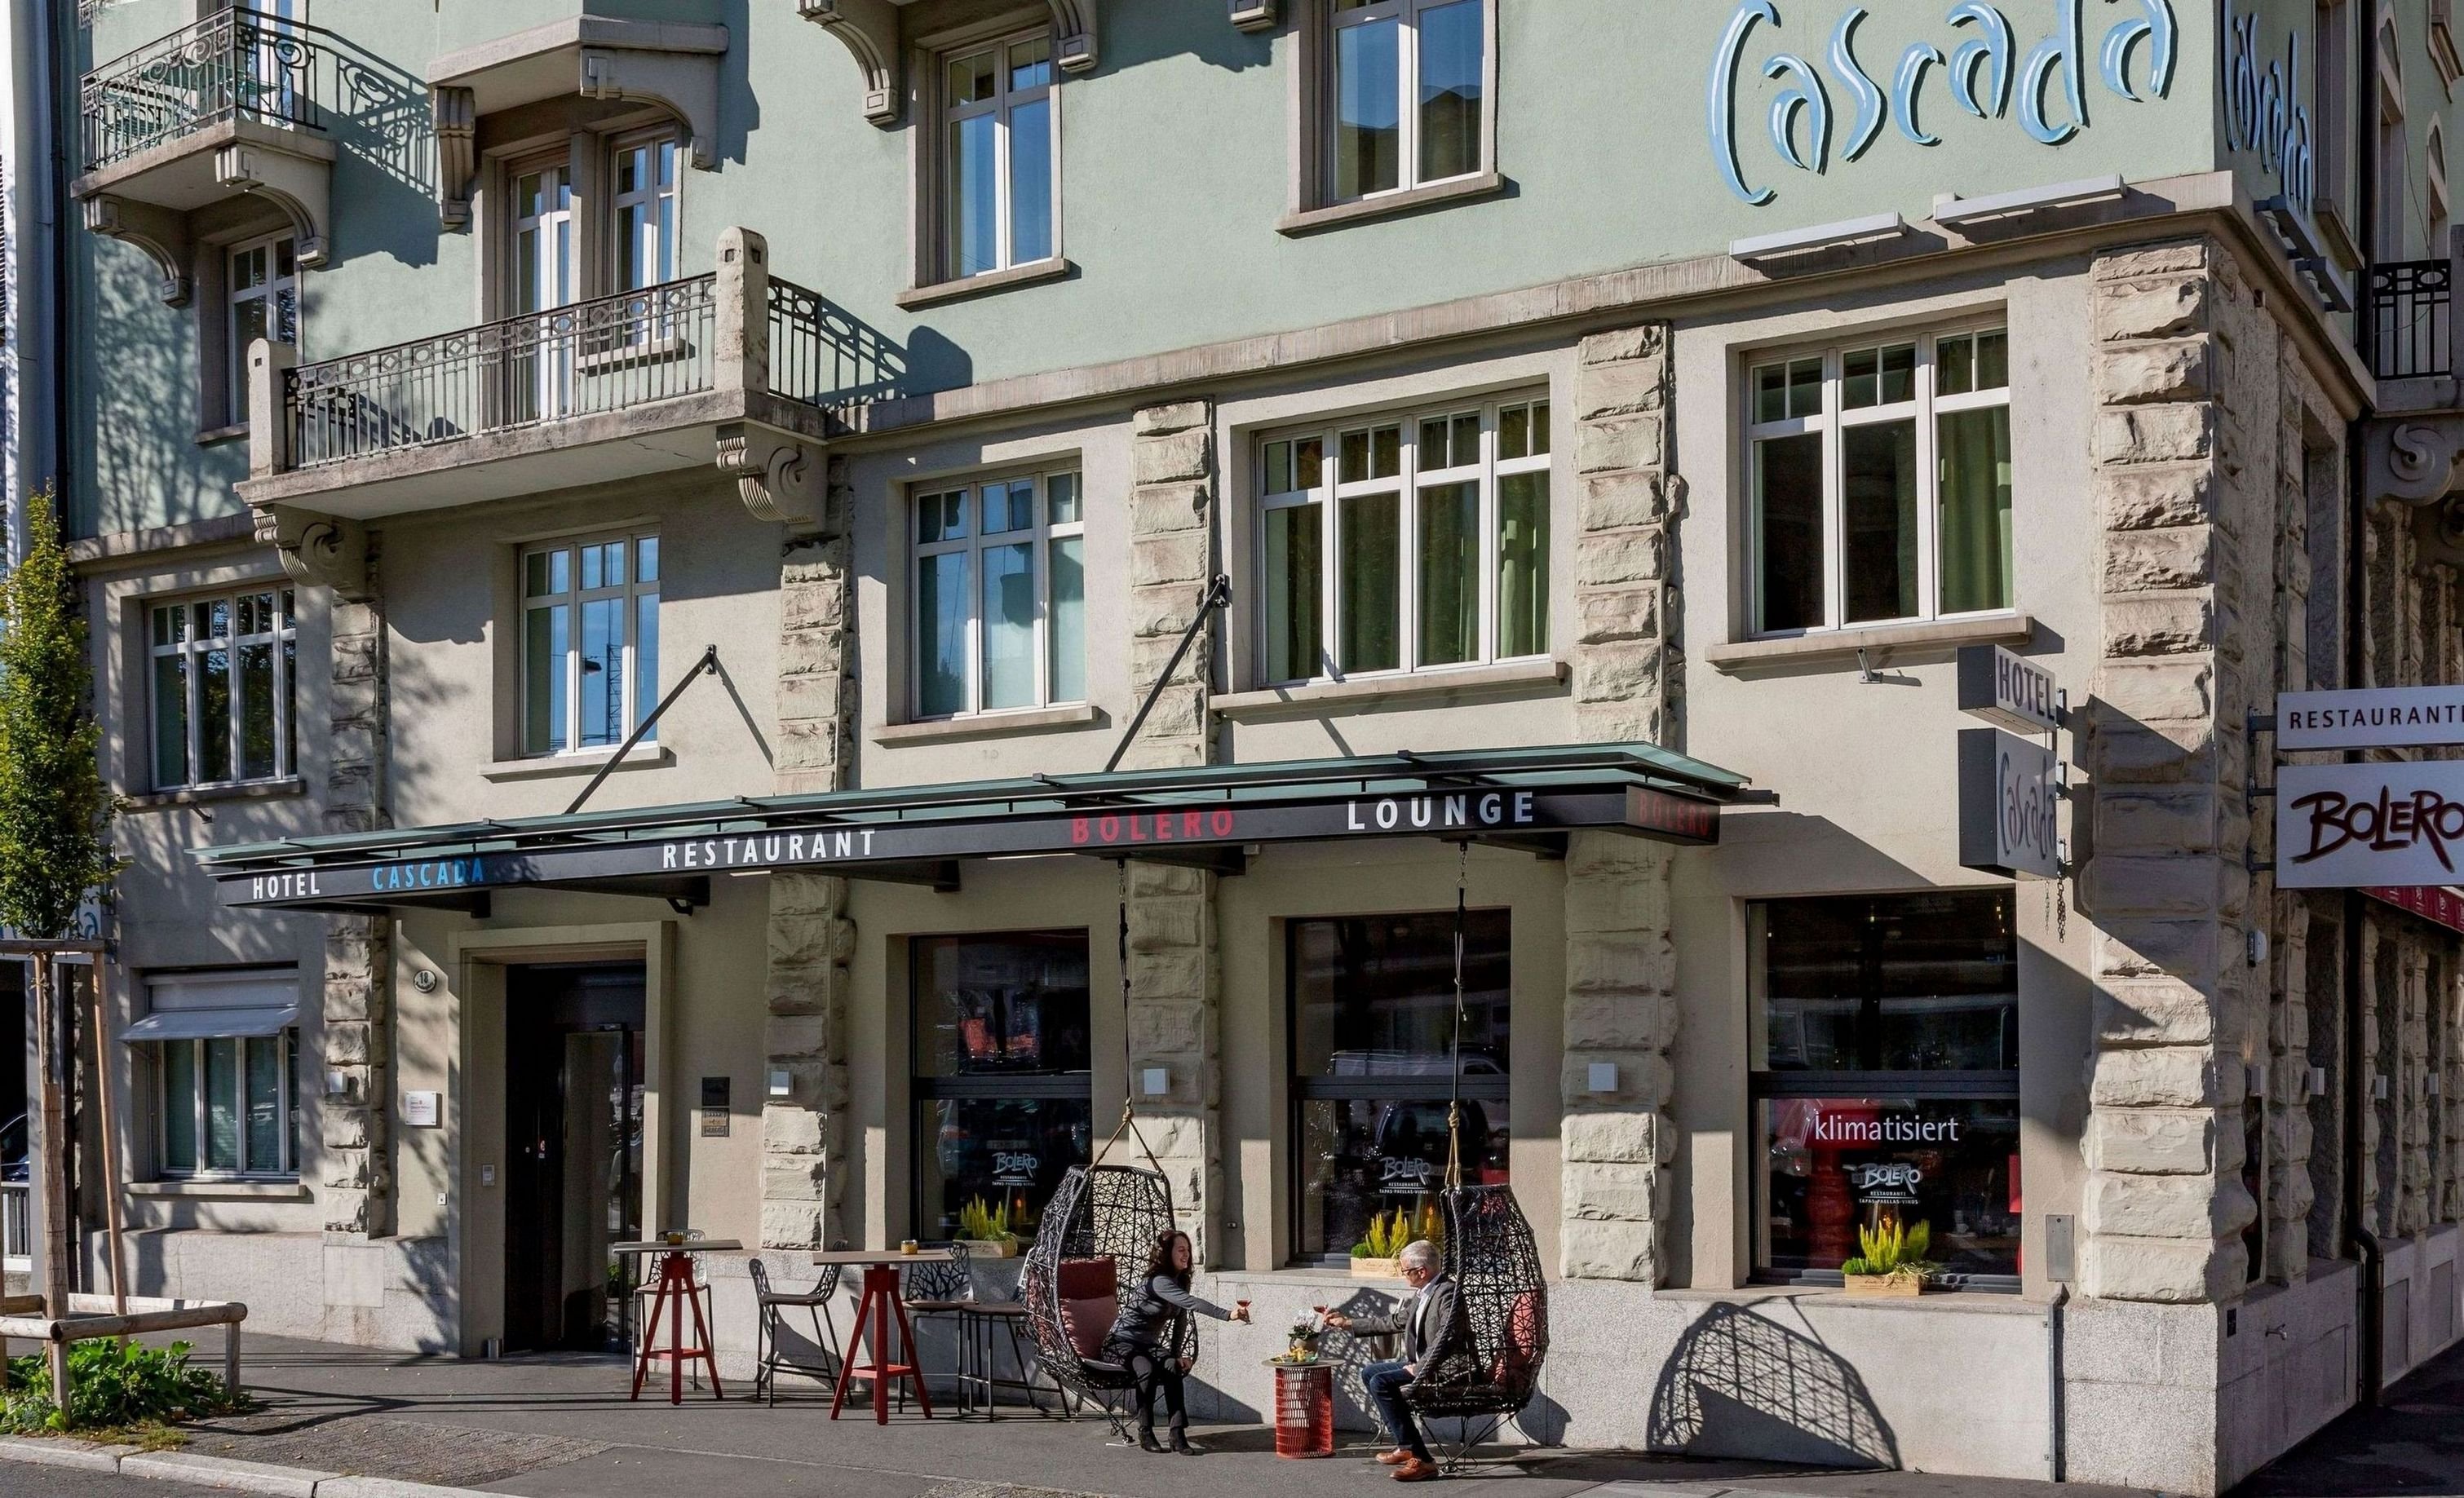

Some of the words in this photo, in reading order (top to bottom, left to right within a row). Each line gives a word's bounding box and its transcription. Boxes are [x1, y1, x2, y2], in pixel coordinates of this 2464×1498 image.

[1706, 0, 2174, 205] Cascada
[1999, 655, 2055, 721] HOTEL
[1639, 793, 1709, 836] BOLERO
[2000, 751, 2055, 860] Cascada
[253, 873, 320, 899] HOTEL
[373, 857, 483, 890] CASCADA
[662, 829, 875, 868] RESTAURANT
[1071, 810, 1233, 844] BOLERO
[1348, 792, 1533, 830] LOUNGE
[2290, 784, 2464, 873] BOLERO
[420, 971, 428, 983] 18
[1815, 1116, 1958, 1141] klimatisiert
[992, 1151, 1037, 1178] BOLERO
[1379, 1156, 1431, 1186] BOLERO
[1859, 1162, 1921, 1195] BOLERO
